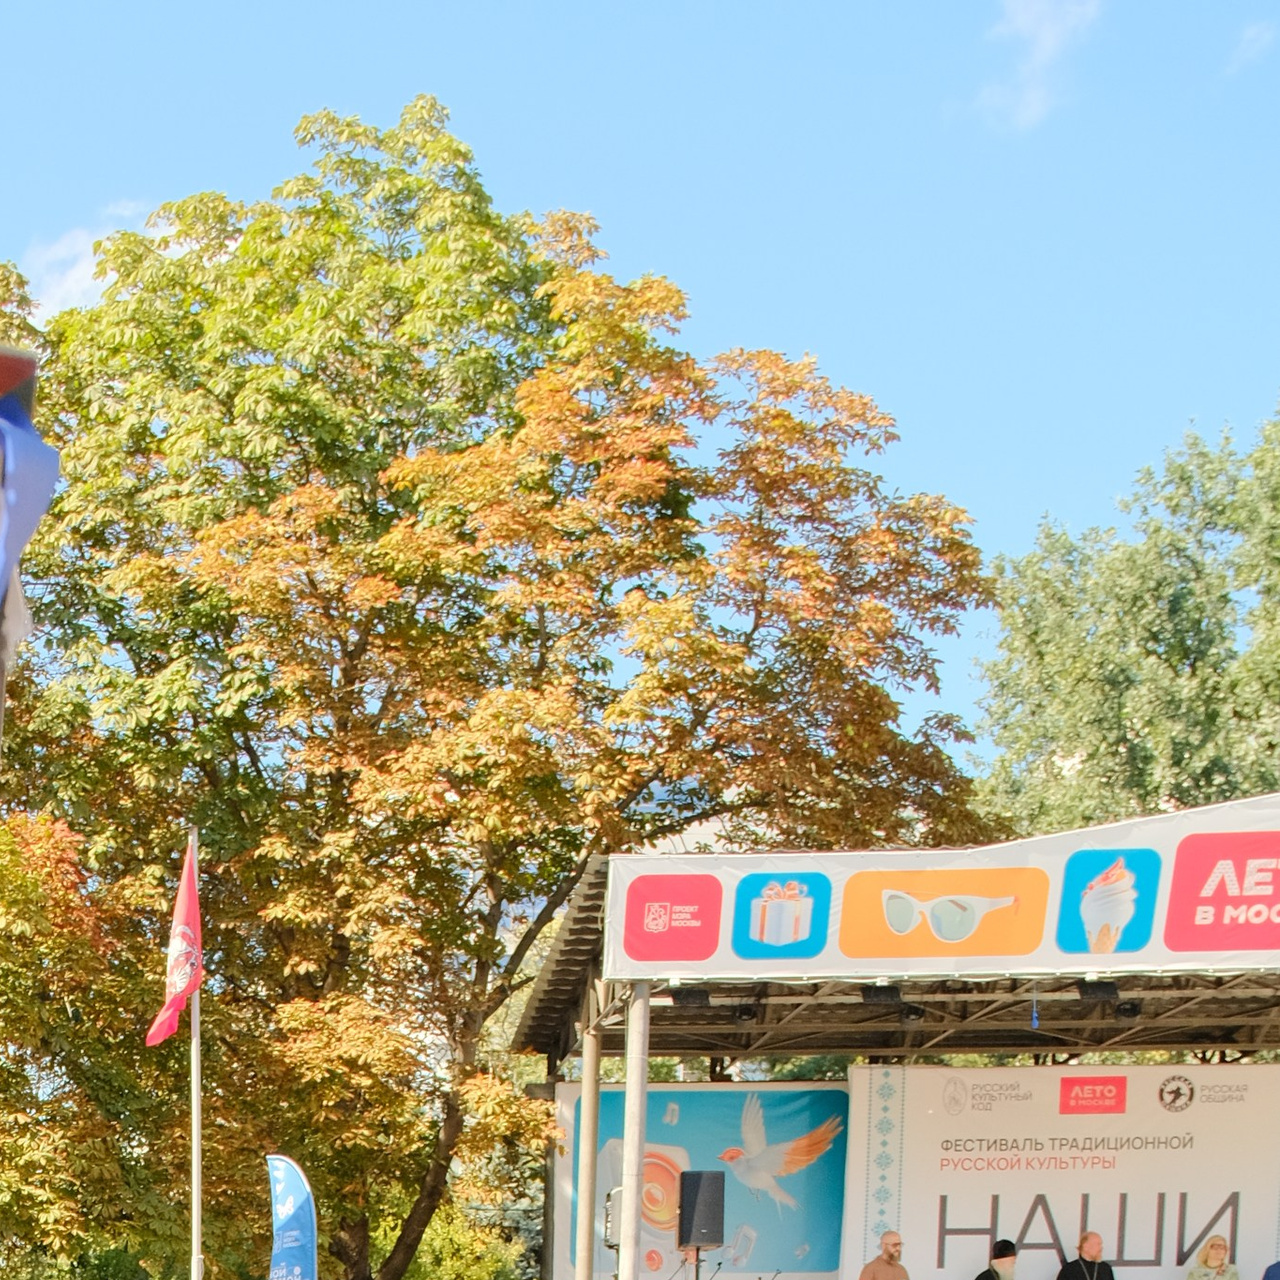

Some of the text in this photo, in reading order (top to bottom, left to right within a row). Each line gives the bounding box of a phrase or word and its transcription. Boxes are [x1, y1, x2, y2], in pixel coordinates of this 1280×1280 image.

[1199, 858, 1280, 898] ЛЕ
[971, 1081, 1020, 1092] РУССКИЙ
[1071, 1084, 1117, 1098] ЛЕТО
[1200, 1084, 1248, 1094] РУССКАЯ
[1200, 1094, 1245, 1104] ОБЩИНА
[971, 1102, 993, 1112] КОД
[940, 1132, 1194, 1152] ФЕСТИВАЛЬ ТРАДИЦИОННОЙ
[939, 1153, 1116, 1171] РУССКОЙ КУЛЬТУРЫ
[937, 1191, 1240, 1269] НАШИ
